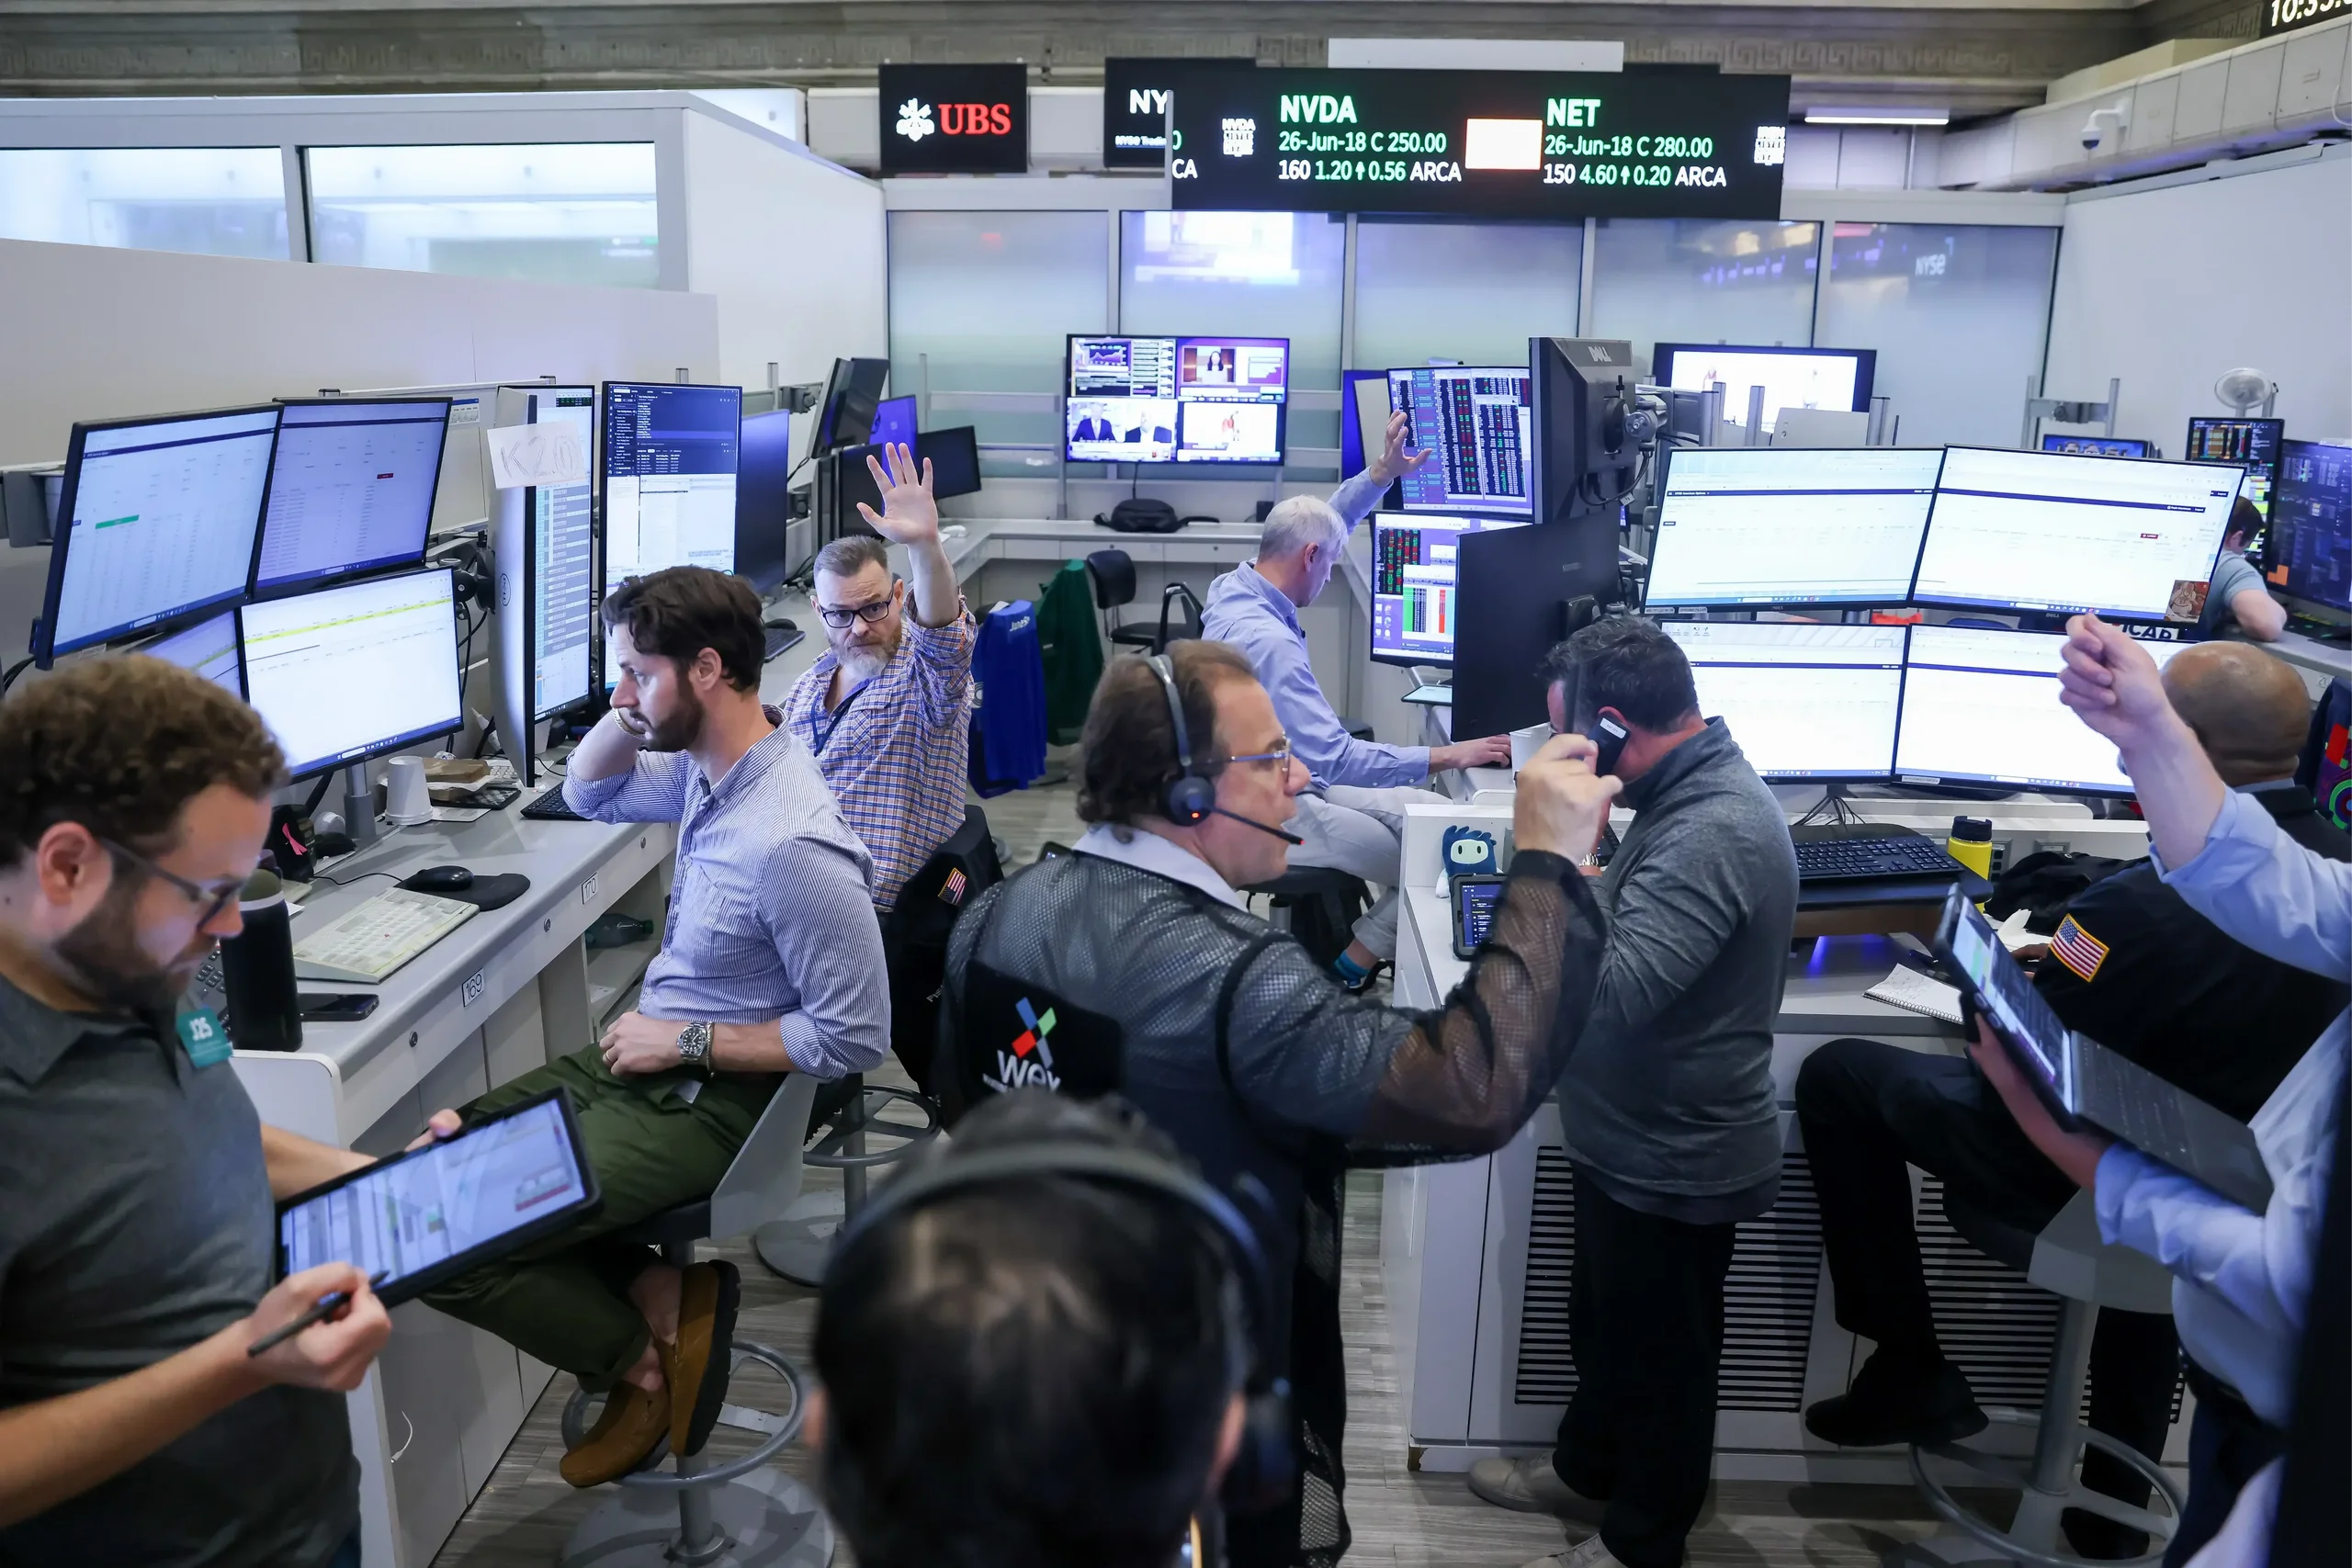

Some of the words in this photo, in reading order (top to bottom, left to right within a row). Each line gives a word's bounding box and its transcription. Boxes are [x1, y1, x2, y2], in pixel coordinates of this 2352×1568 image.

[938, 104, 1012, 135] UBS
[1280, 95, 1358, 123] NVDA
[1546, 98, 1601, 127] NET
[1279, 130, 1366, 152] 26-Jun-18
[1371, 132, 1384, 152] C
[1387, 132, 1447, 153] 250.00
[1544, 135, 1633, 156] 26-Jun-18
[1636, 137, 1650, 156] C
[1653, 137, 1713, 158] 280.00
[1279, 160, 1311, 180] 160
[1315, 161, 1352, 181] 1.20
[1368, 161, 1407, 181] 0.56
[1409, 162, 1463, 182] ARCA
[1544, 164, 1577, 184] 150
[1578, 164, 1617, 185] 4.60
[1634, 165, 1671, 186] 0.20
[1674, 166, 1727, 187] ARCA
[584, 877, 597, 899] 170
[466, 973, 483, 1000] 169
